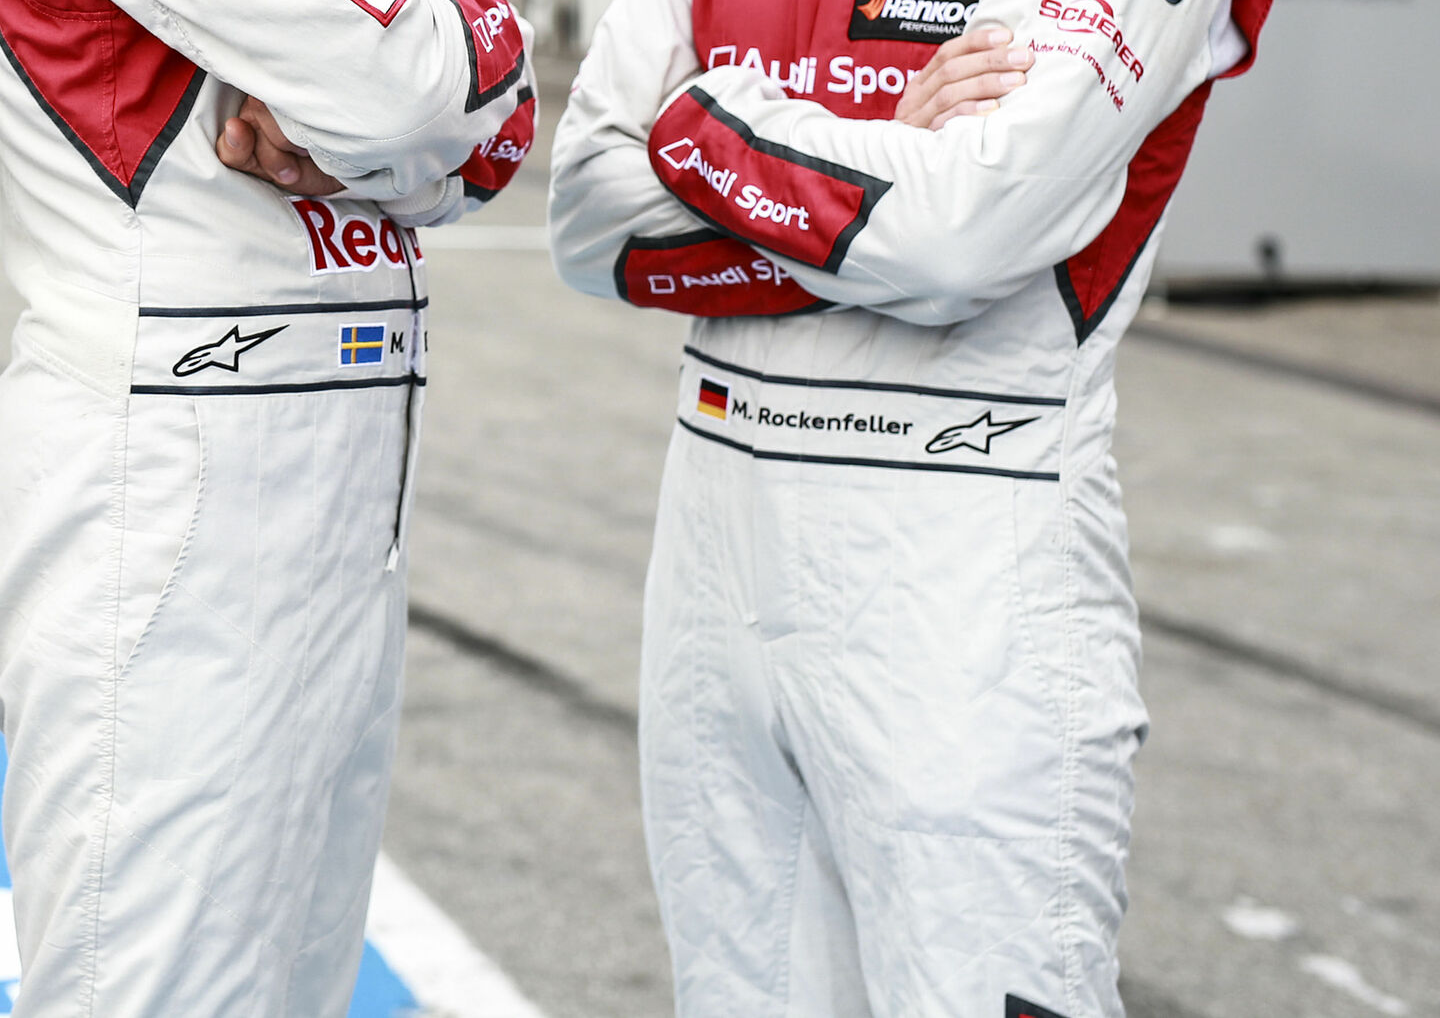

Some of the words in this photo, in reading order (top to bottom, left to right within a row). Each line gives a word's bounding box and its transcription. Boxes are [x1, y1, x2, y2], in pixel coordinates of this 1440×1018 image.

[683, 148, 738, 197] Audi
[734, 184, 810, 230] Sport
[681, 265, 751, 289] Audi
[732, 399, 753, 420] M.
[757, 408, 913, 436] Rockenfeller
